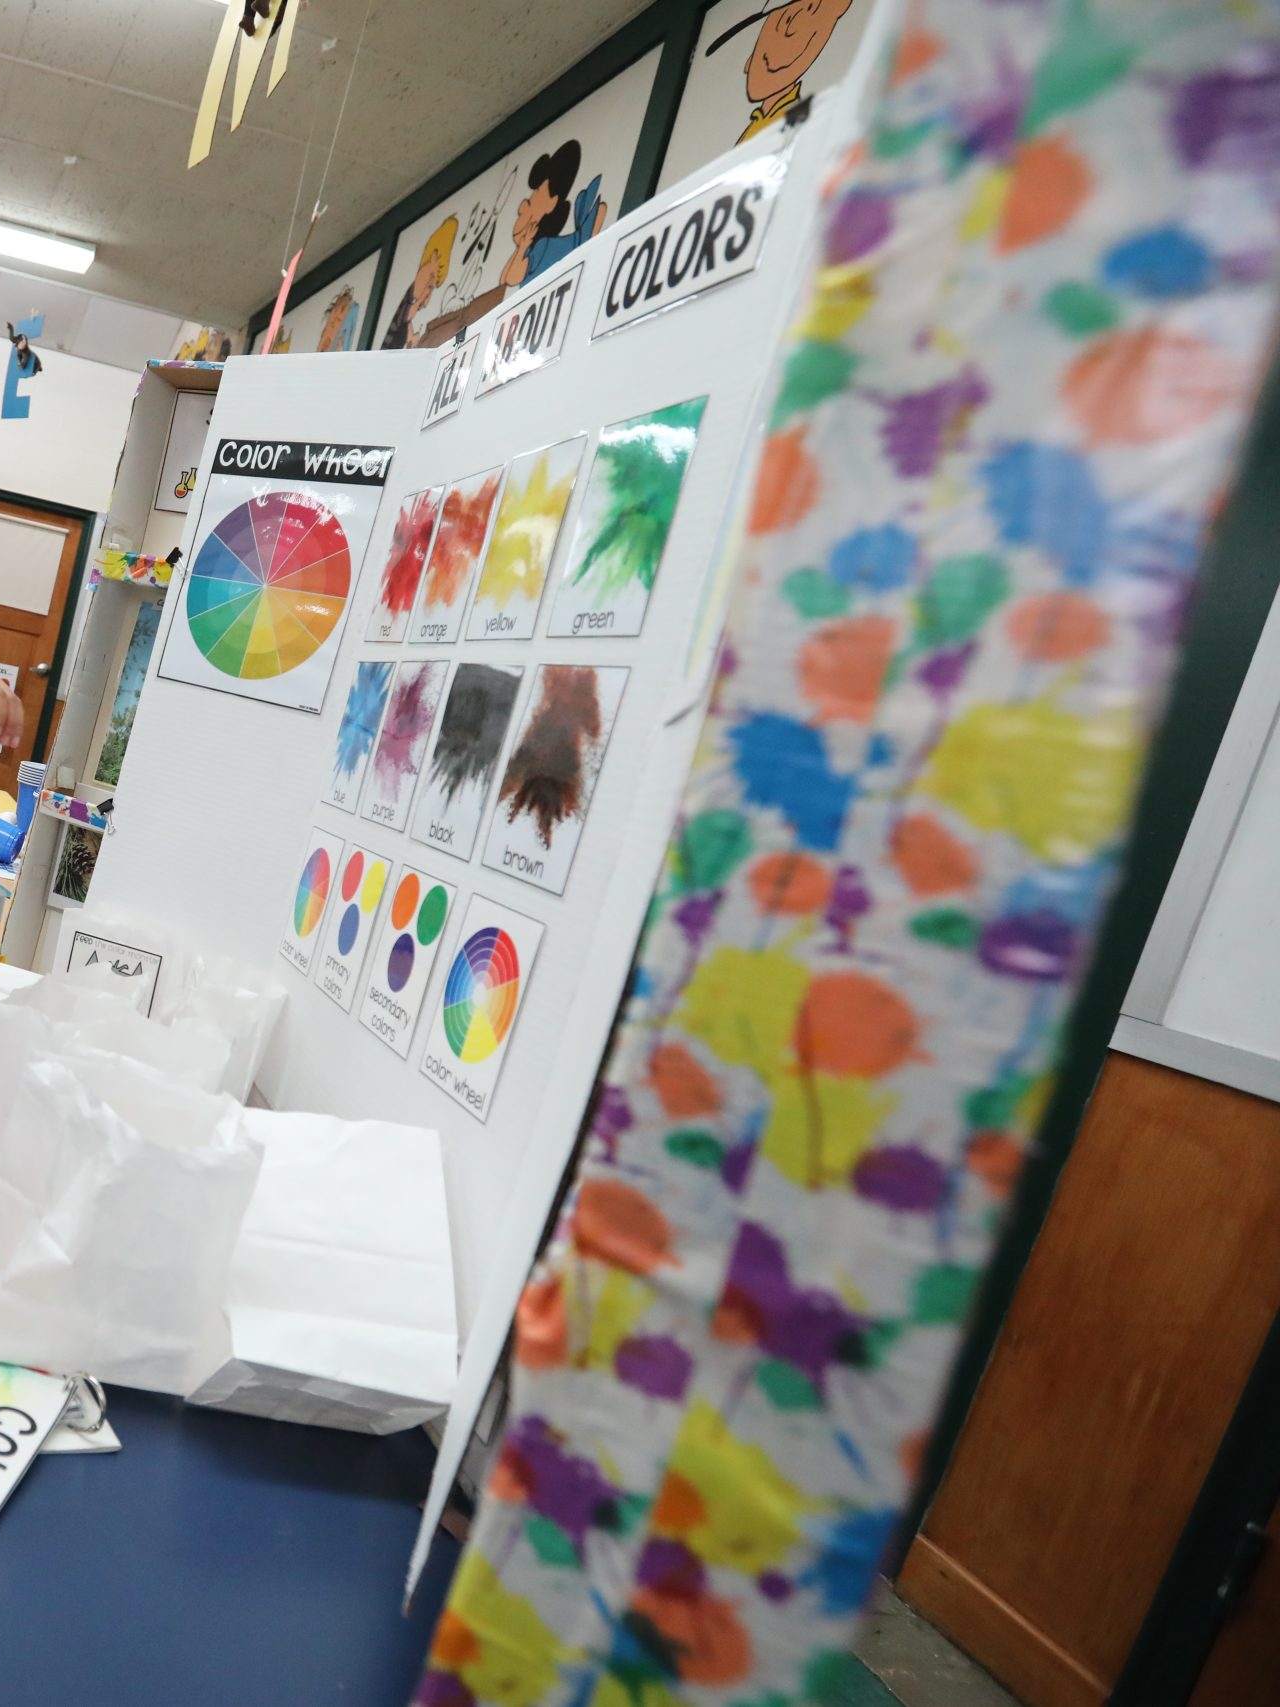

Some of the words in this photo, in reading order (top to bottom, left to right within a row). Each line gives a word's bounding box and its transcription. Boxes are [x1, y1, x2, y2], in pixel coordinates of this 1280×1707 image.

[427, 352, 466, 419] ALL
[606, 182, 764, 317] COLORS
[420, 623, 448, 641] orange
[484, 612, 518, 636] yellow
[572, 610, 616, 635] green
[333, 787, 346, 804] blue
[371, 802, 396, 822] purple
[428, 819, 456, 845] black
[502, 844, 545, 880] brown
[325, 955, 352, 985] primary
[323, 976, 343, 1001] colors
[369, 986, 412, 1031] secondary
[371, 1014, 396, 1042] colors
[425, 1054, 453, 1081] color
[453, 1075, 487, 1113] wheel
